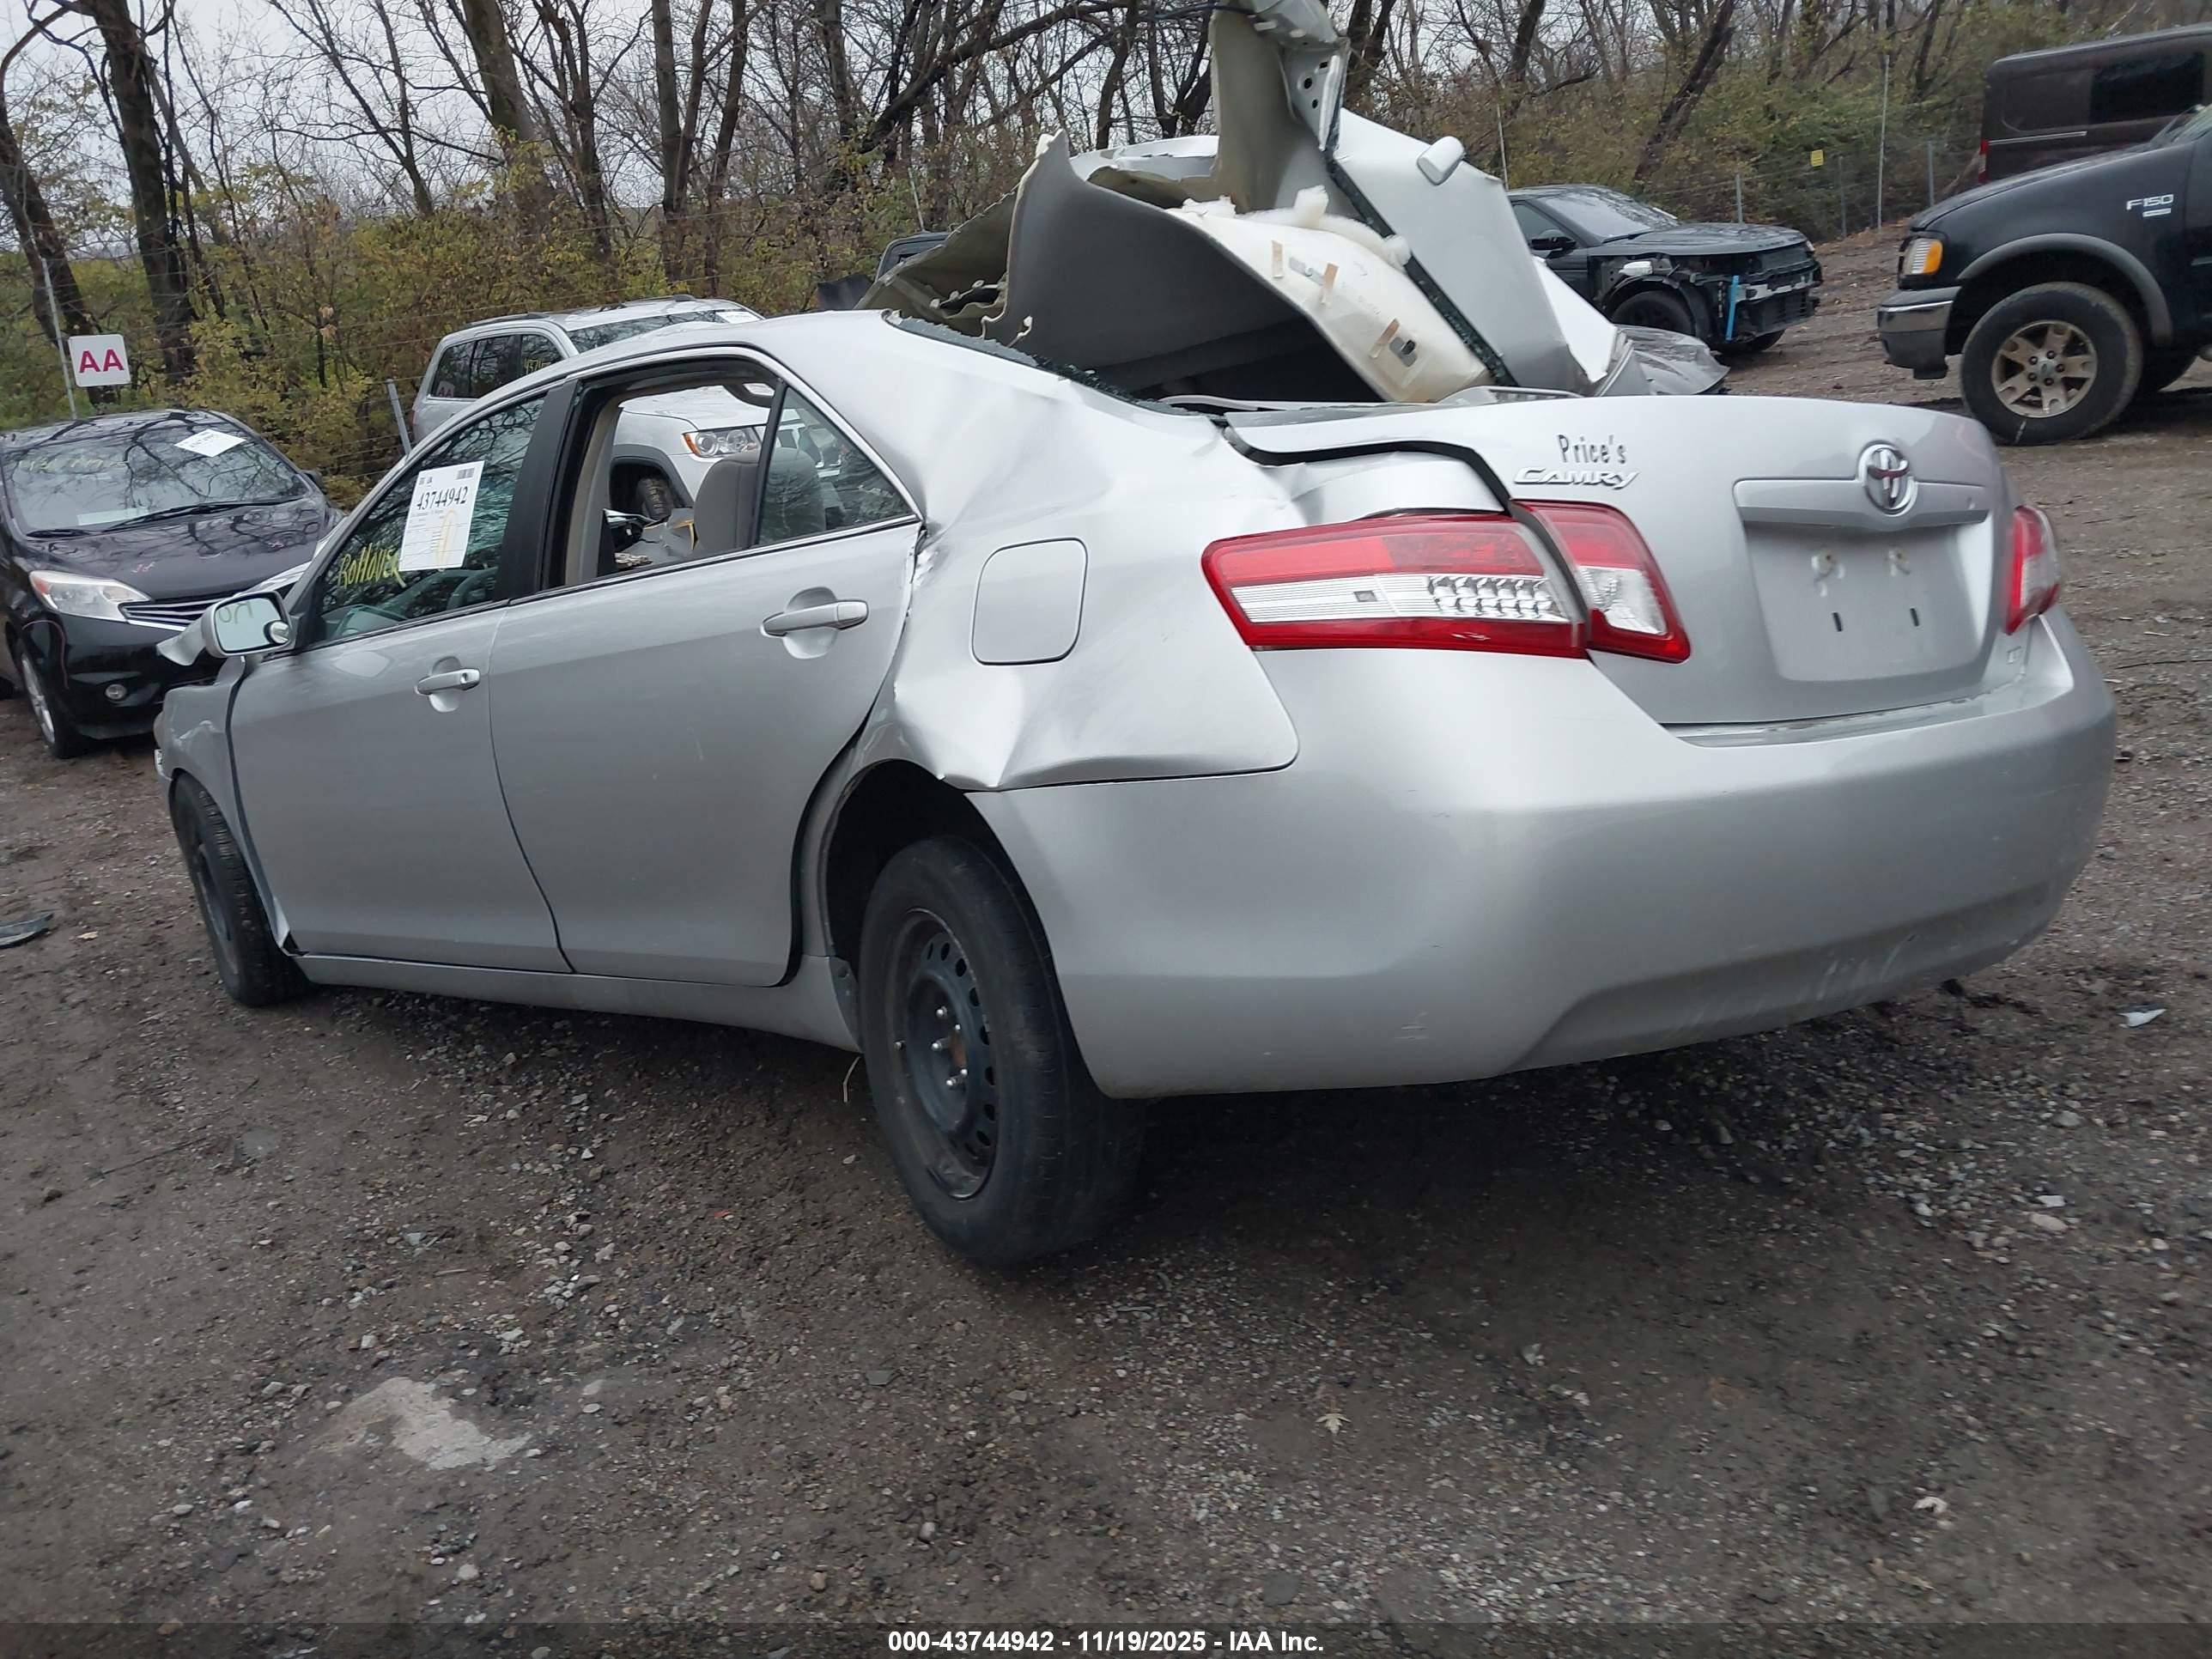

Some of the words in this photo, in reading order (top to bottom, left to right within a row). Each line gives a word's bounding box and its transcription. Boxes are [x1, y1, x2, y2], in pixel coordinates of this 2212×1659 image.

[79, 349, 125, 374] AA
[1557, 434, 1626, 465] Price's
[1514, 467, 1639, 490] CAMRY
[416, 486, 469, 510] 43744942
